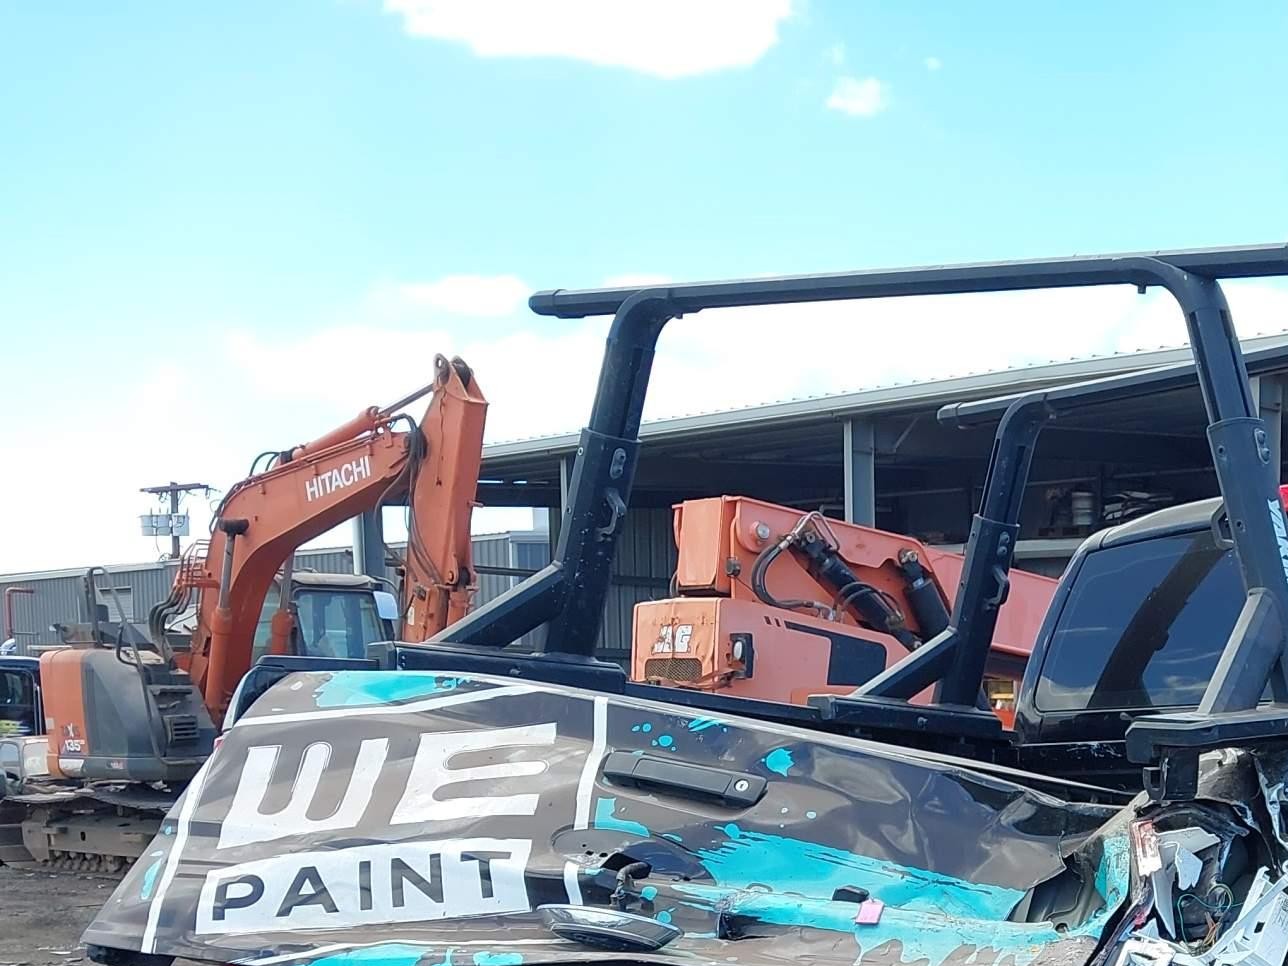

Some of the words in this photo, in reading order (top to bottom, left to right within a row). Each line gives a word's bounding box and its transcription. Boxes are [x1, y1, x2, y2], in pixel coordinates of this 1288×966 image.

[304, 455, 371, 502] HITACHI
[216, 722, 557, 850] WE
[211, 850, 512, 922] PAINT
